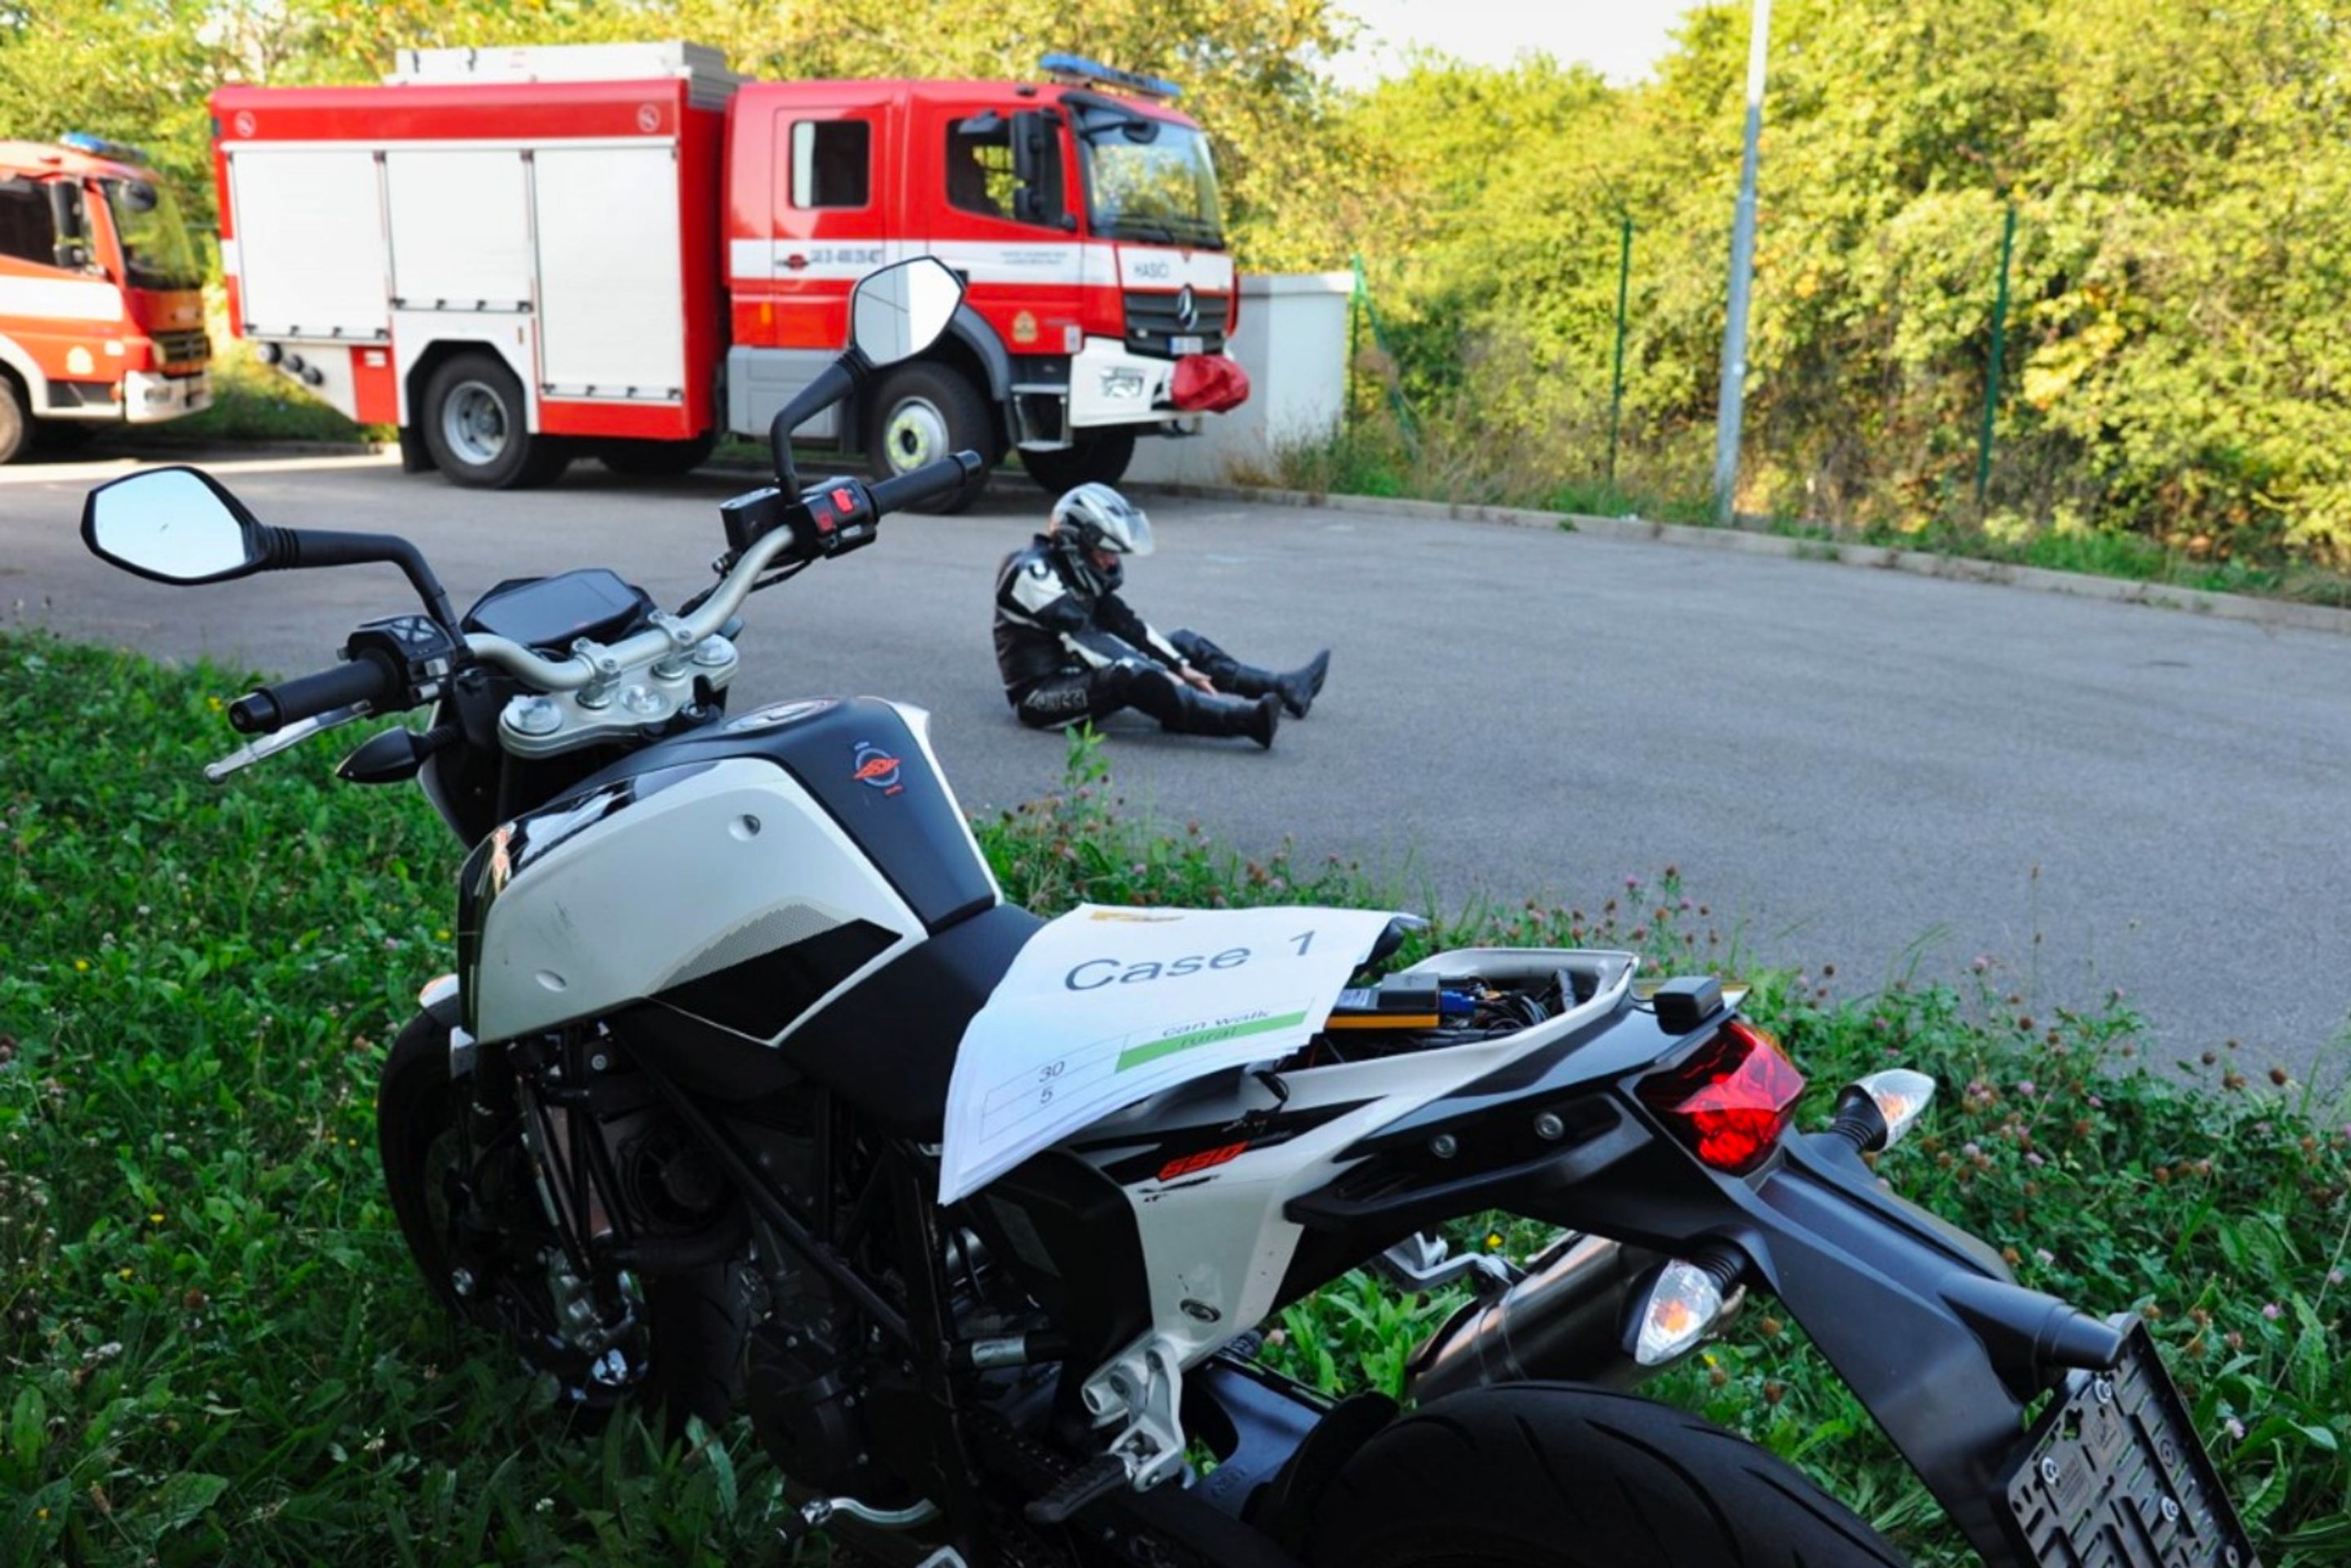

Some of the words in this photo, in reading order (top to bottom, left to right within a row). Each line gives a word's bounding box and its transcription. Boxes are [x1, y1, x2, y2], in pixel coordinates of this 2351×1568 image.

[1064, 947, 1251, 991] Case
[1288, 930, 1315, 956] 1
[1162, 1021, 1207, 1038] can
[1215, 1009, 1271, 1027] walk
[1038, 1060, 1065, 1083] 30
[1040, 1085, 1054, 1104] 5
